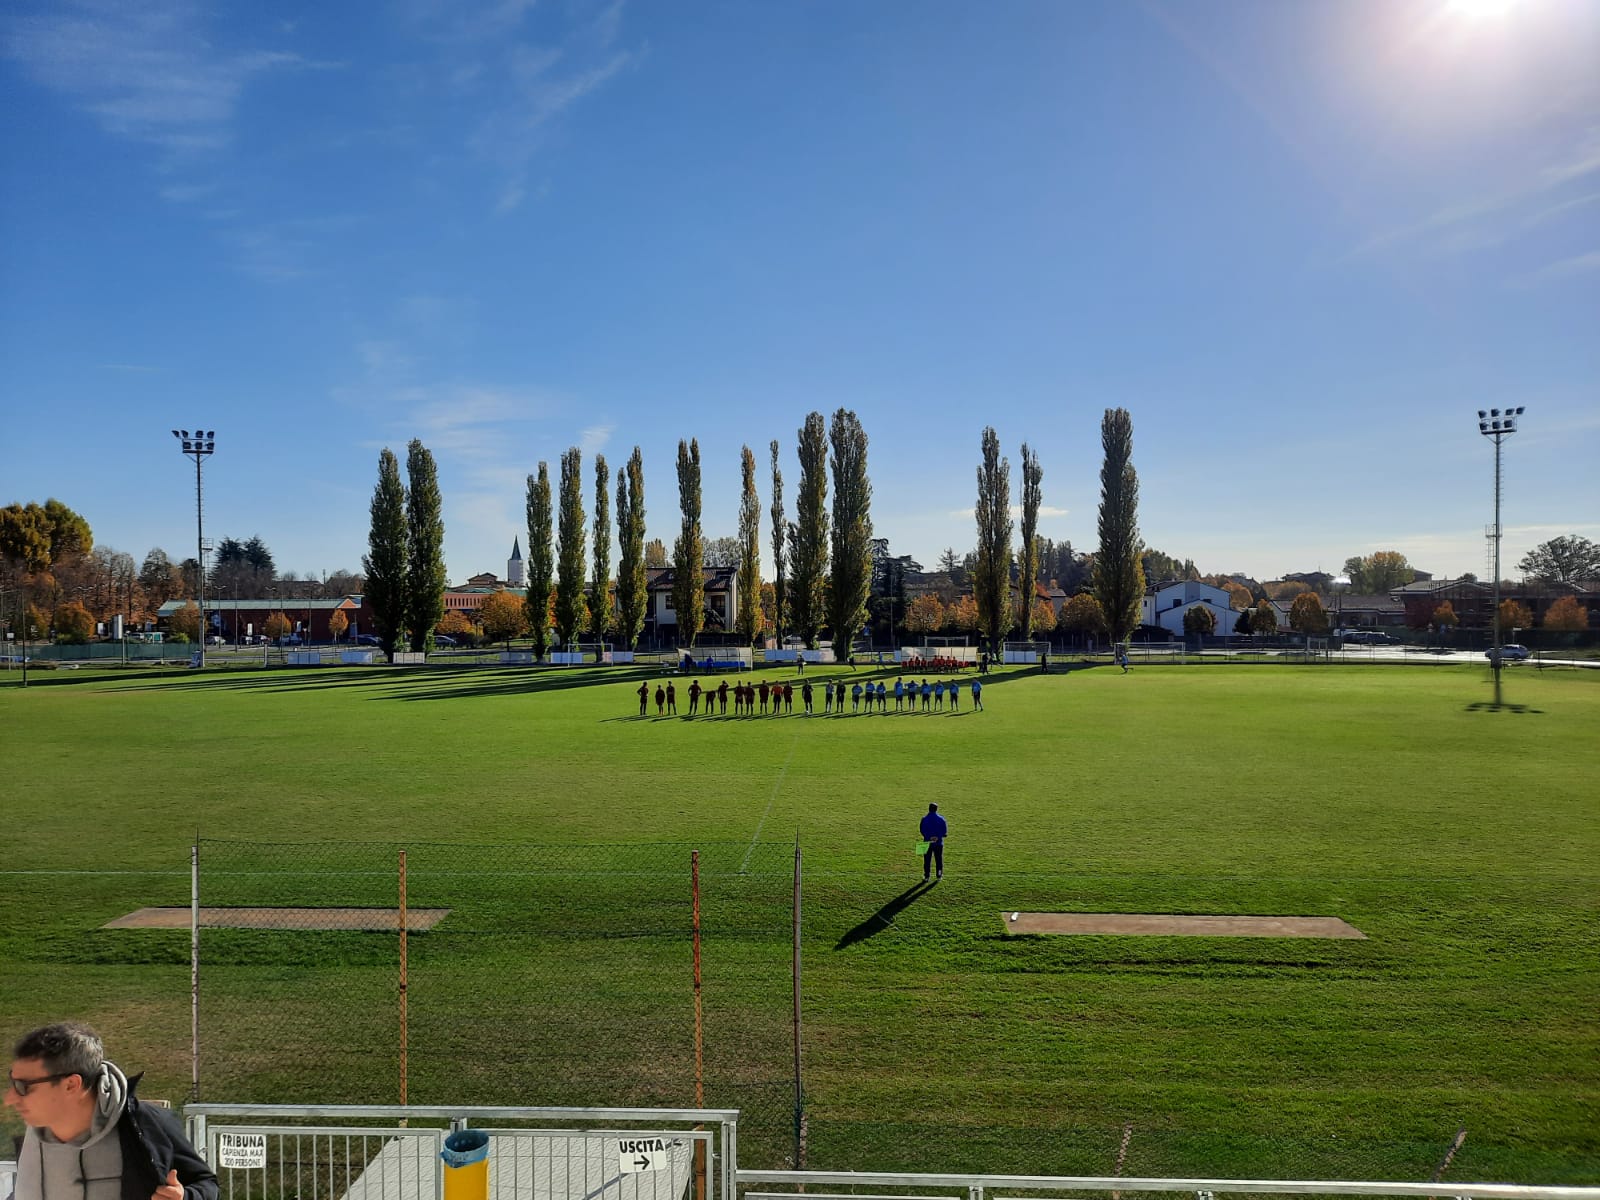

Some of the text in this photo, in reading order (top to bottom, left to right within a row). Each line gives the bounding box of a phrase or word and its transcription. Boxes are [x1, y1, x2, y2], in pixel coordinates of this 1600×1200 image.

[222, 1134, 264, 1147] TRIBUNA
[619, 1139, 664, 1154] USCITA
[249, 1148, 264, 1157] MAX
[235, 1158, 261, 1167] PERSONE
